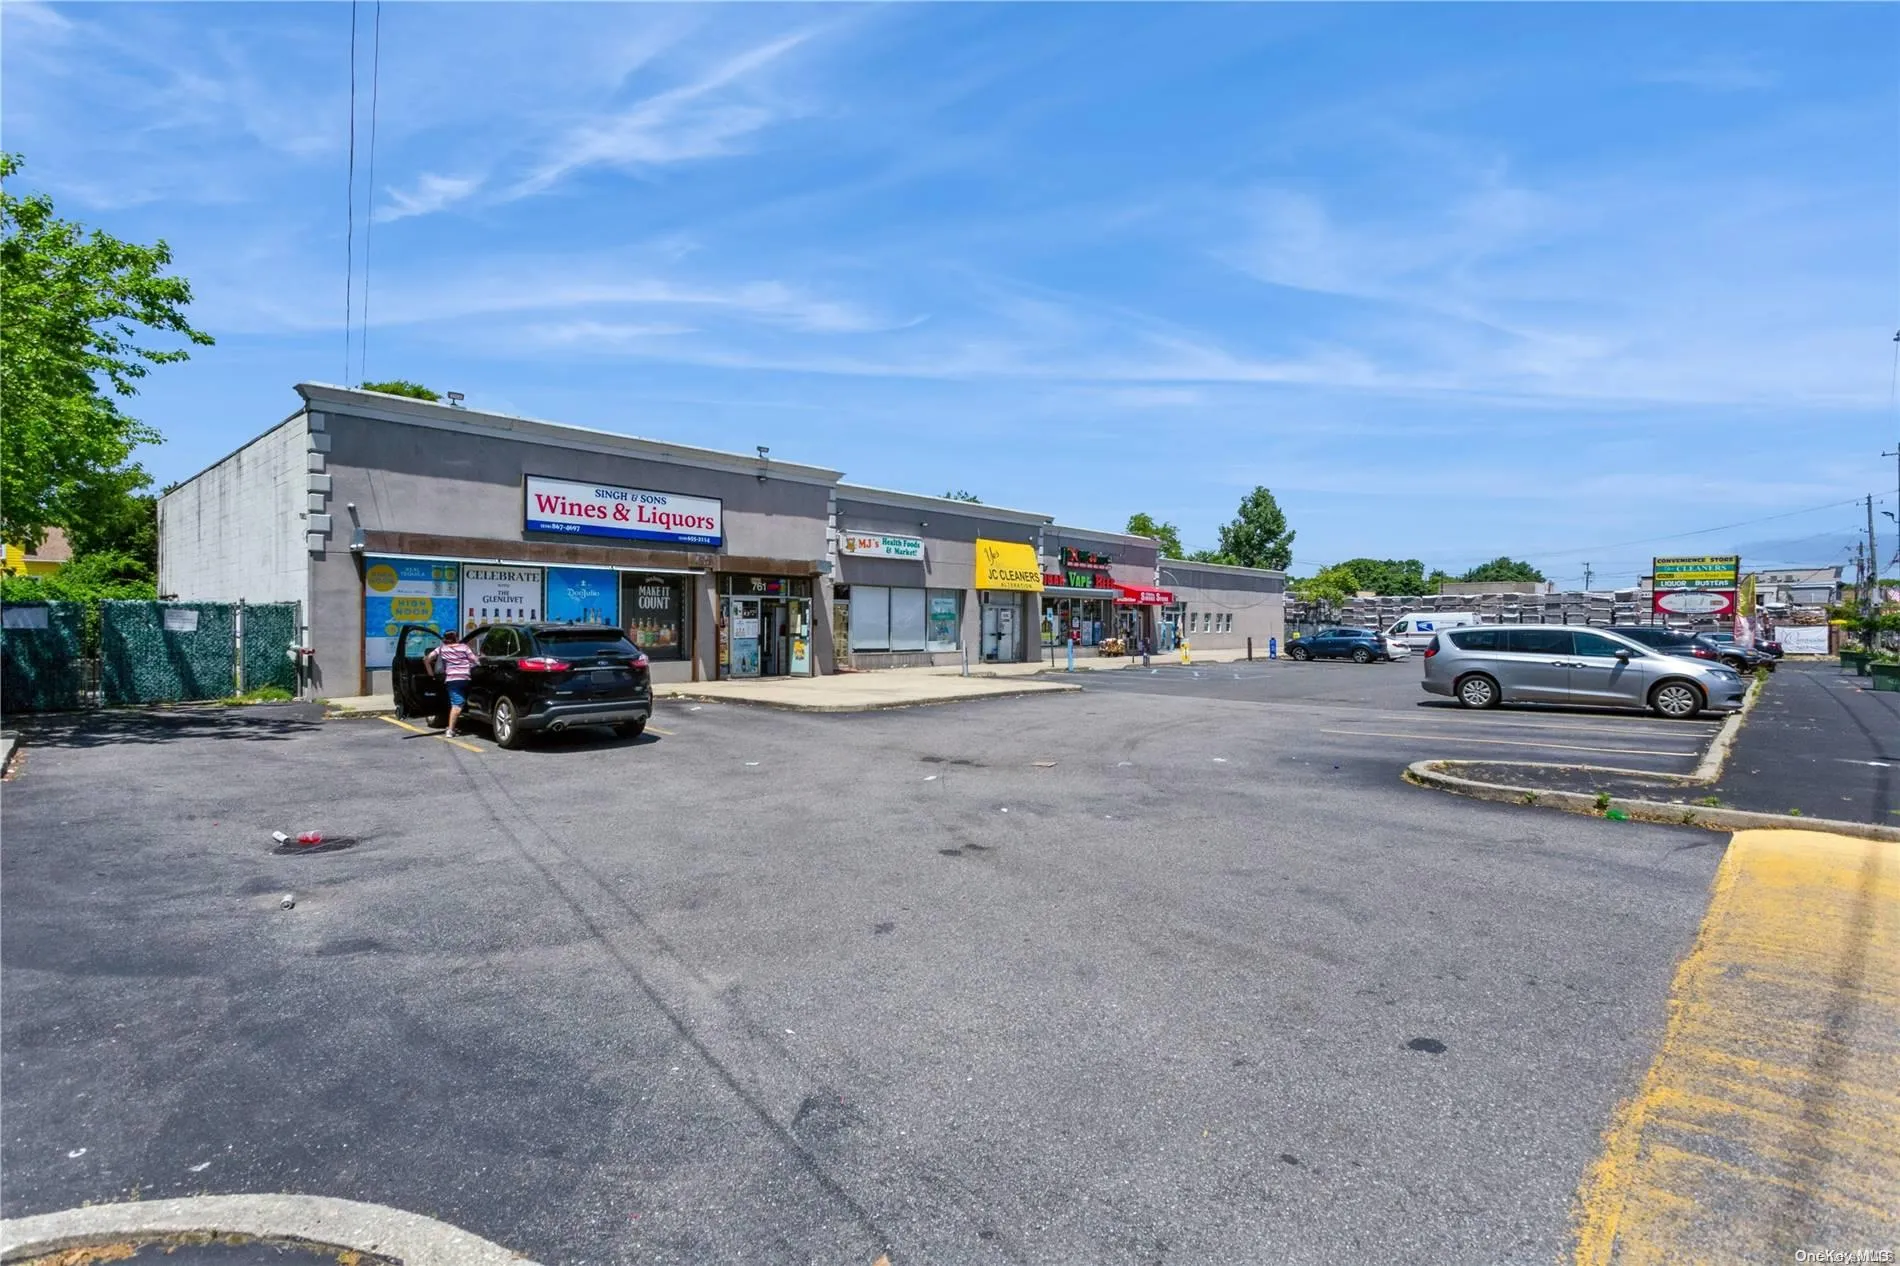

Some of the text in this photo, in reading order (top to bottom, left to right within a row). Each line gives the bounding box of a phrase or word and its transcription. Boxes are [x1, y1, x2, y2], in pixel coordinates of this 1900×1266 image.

[595, 489, 667, 505] SINGH & SONS
[534, 494, 714, 530] Wines & Liquors
[858, 538, 920, 548] MJ's Health Foods
[466, 570, 540, 582] CELEBRATE
[988, 568, 1040, 583] JC CLEANERS
[638, 585, 670, 597] MAKE IT
[752, 583, 766, 591] 761
[482, 595, 524, 604] GLENLIVET
[638, 596, 670, 609] COUNT
